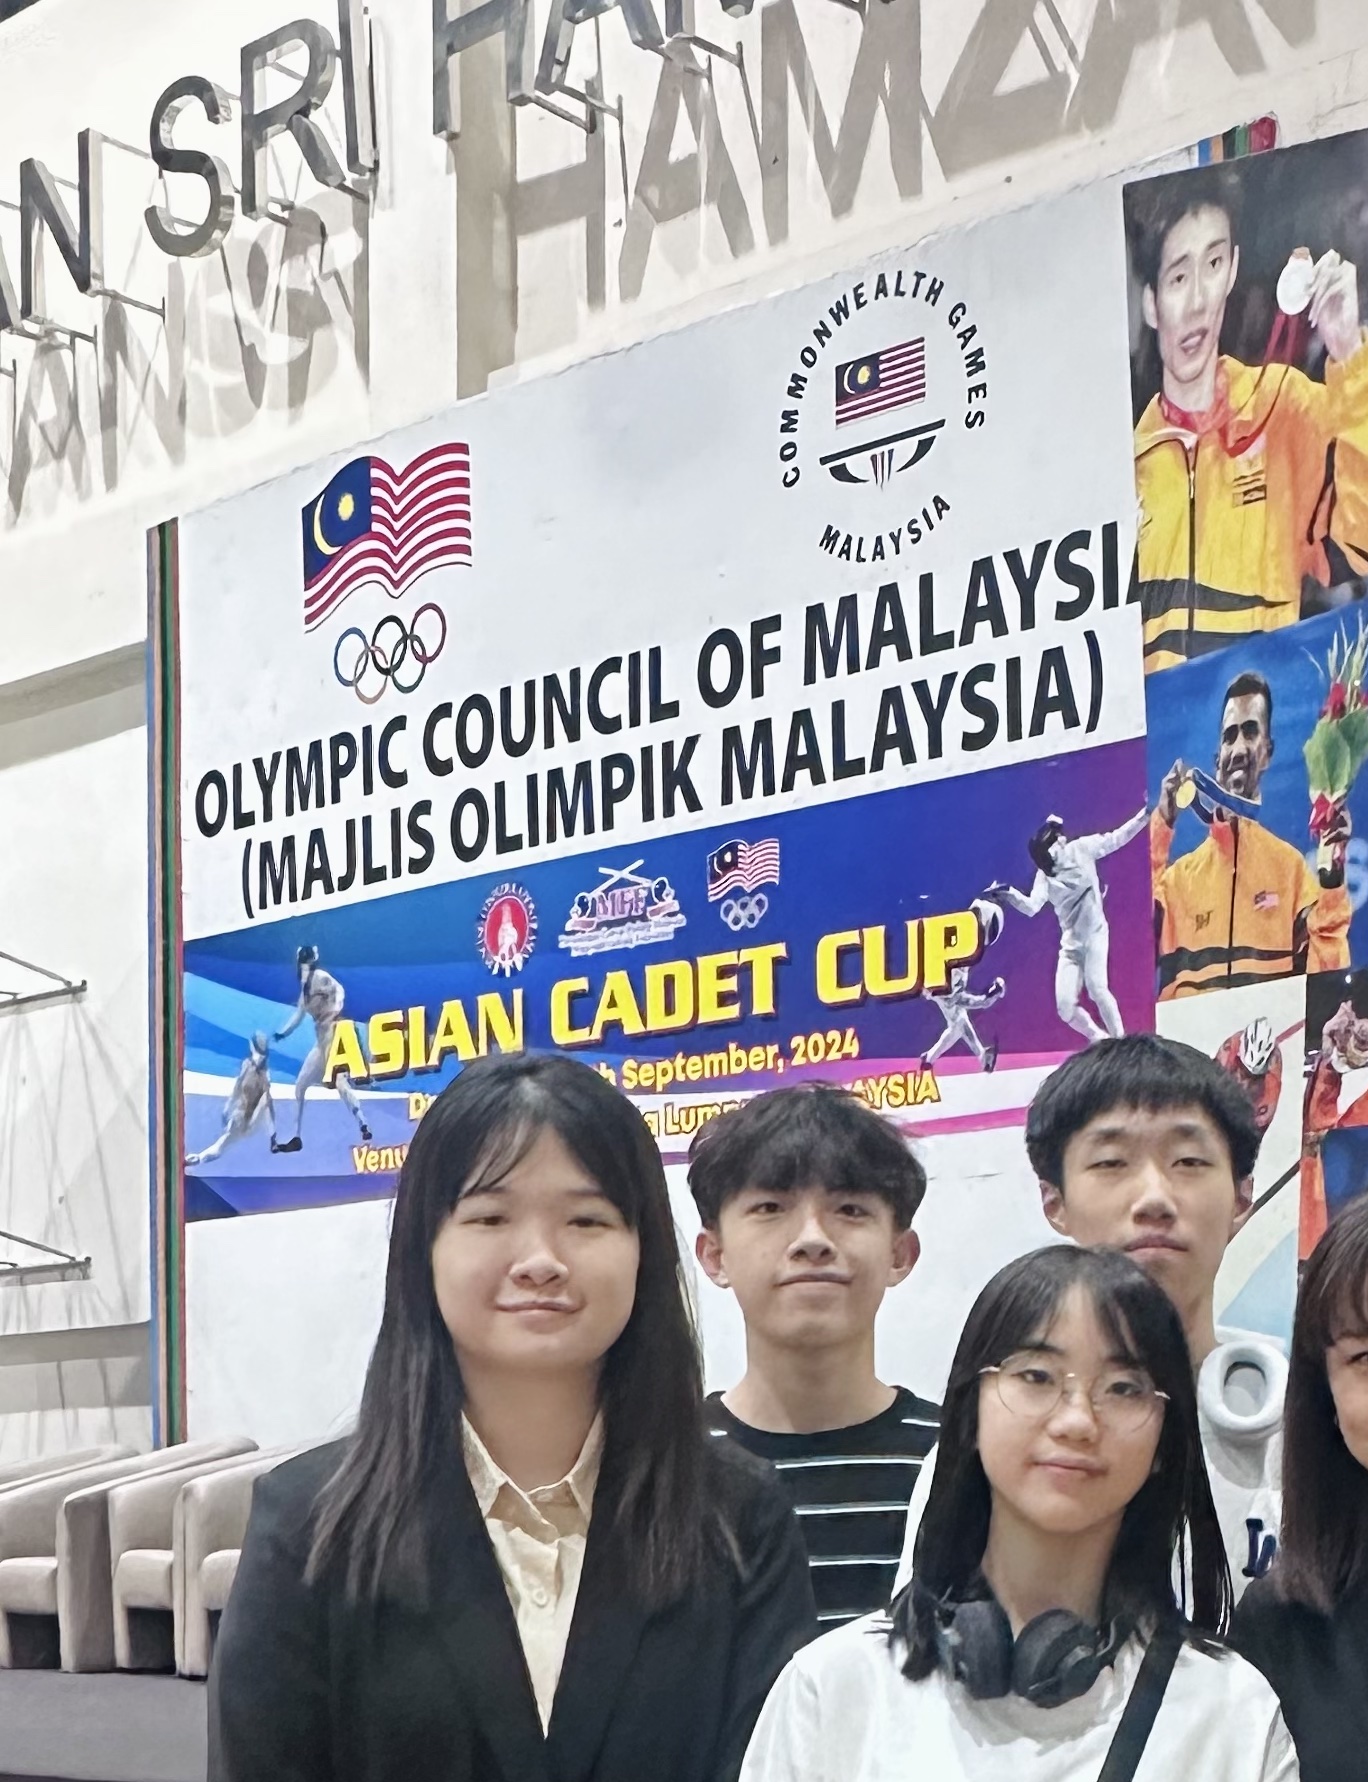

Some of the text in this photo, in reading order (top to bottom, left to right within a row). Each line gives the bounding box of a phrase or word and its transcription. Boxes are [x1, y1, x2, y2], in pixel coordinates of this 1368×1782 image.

[145, 0, 378, 259] SRI
[780, 270, 987, 488] COMMONWEALTH GAMES
[818, 494, 951, 563] MALAYSIA
[194, 715, 409, 838] OLYMPIC
[420, 646, 680, 776] COUNCIL
[696, 612, 783, 711] OF
[242, 629, 1102, 919] (MAJLIS OLIMPIK MALAYSIA)
[322, 908, 984, 1090] ASIAN CADET CUP
[621, 1042, 786, 1094] September,
[789, 1027, 860, 1066] 2024
